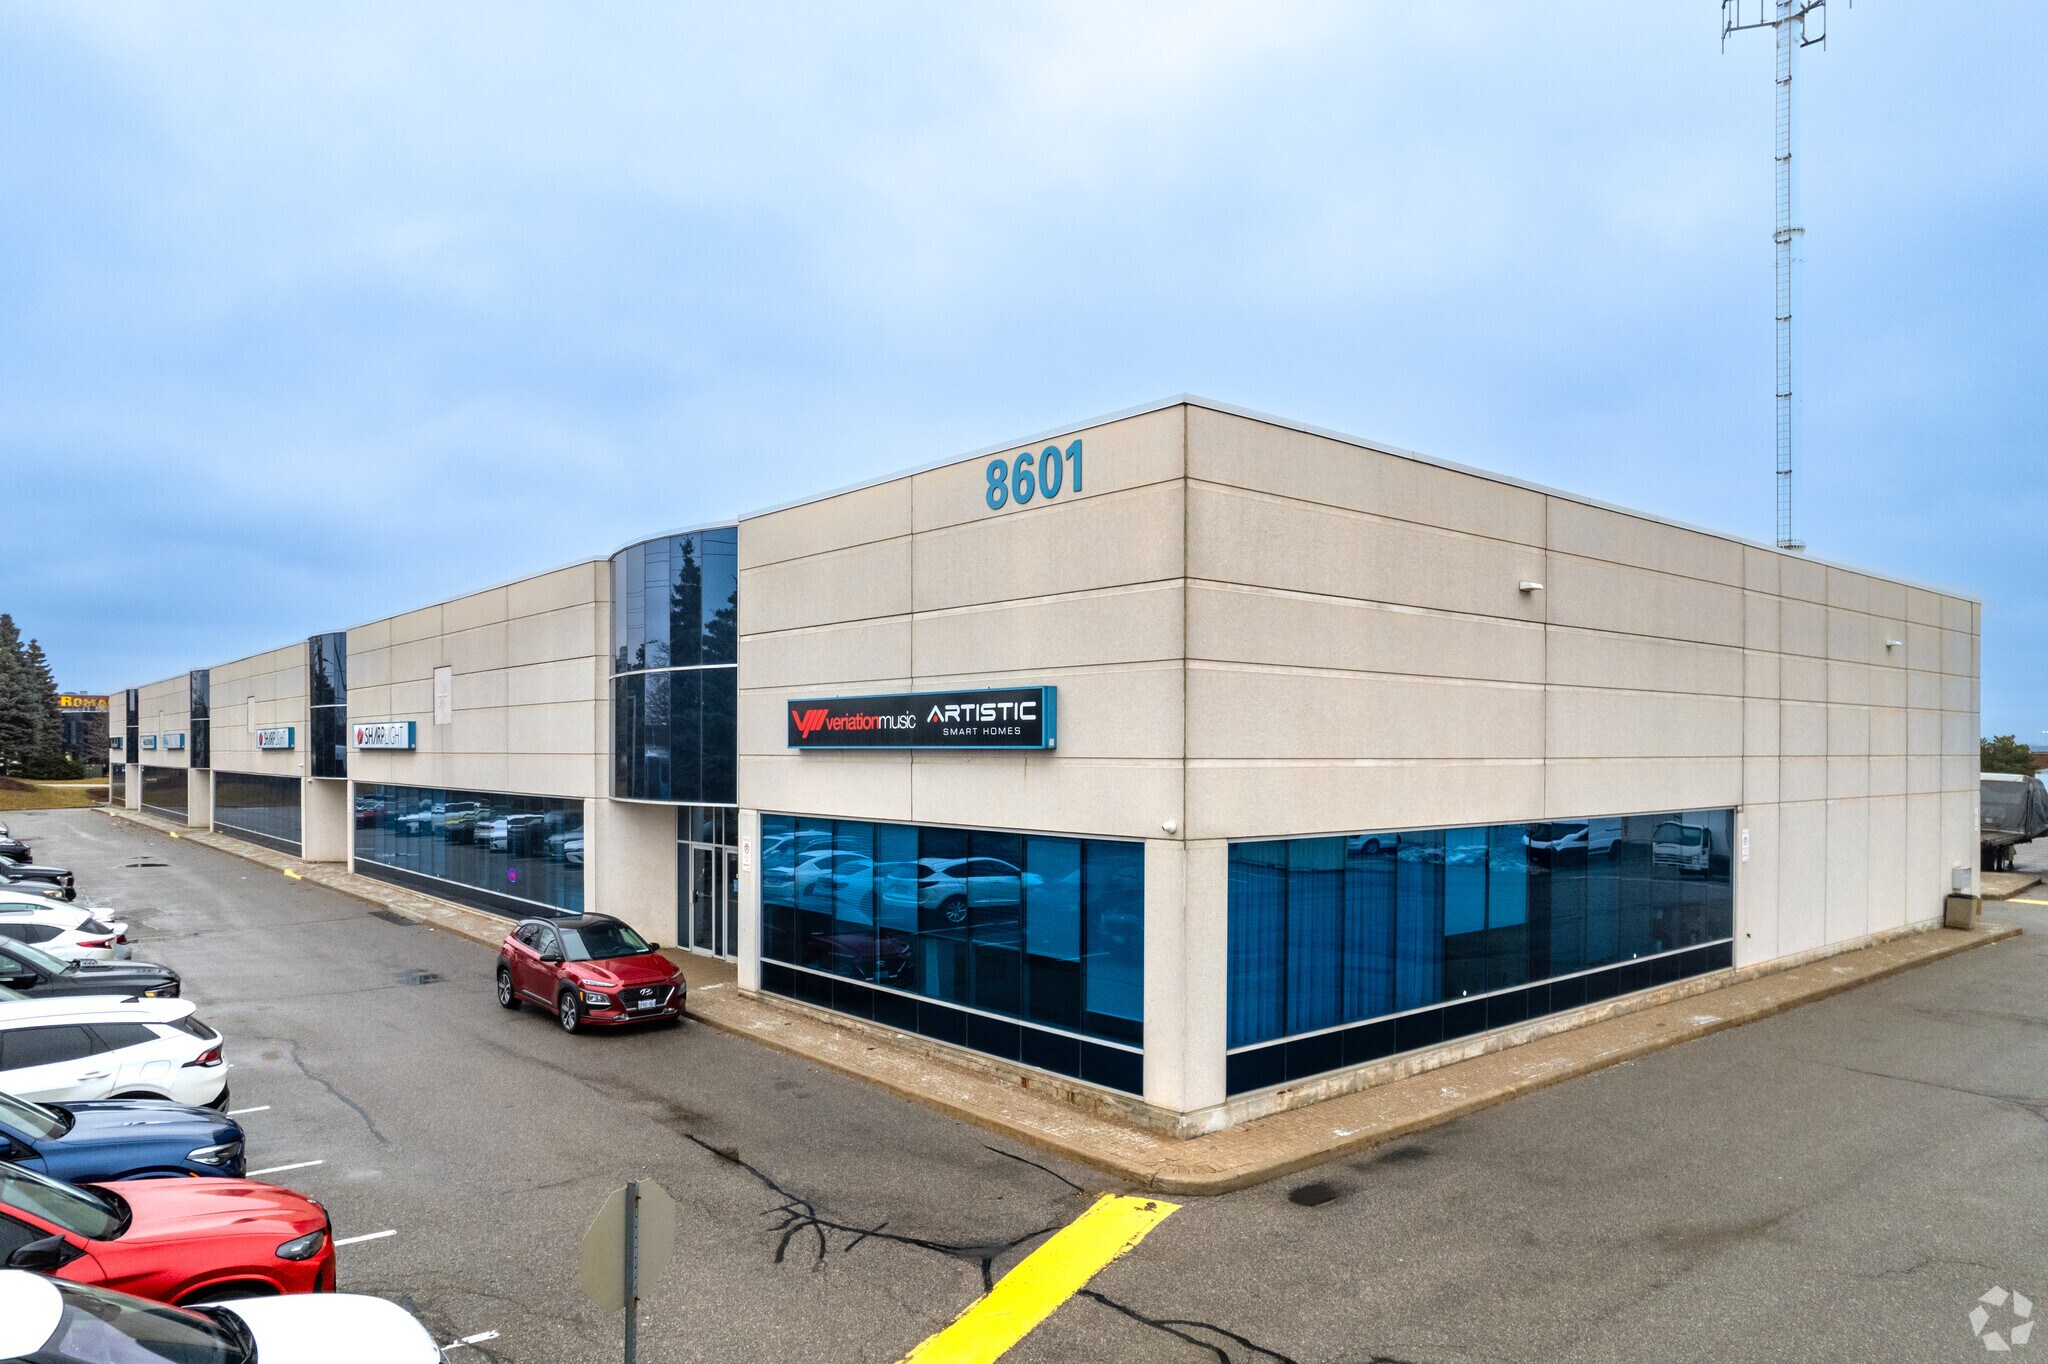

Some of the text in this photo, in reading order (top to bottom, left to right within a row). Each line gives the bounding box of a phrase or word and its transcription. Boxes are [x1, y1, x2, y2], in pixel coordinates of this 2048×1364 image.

[986, 439, 1082, 510] 8601
[61, 696, 109, 707] ROMA
[826, 711, 916, 730] veriationmusic
[926, 701, 1036, 723] ARTISTIC
[365, 726, 403, 745] SHARPLIGHT
[943, 726, 1021, 736] SMART HOMES
